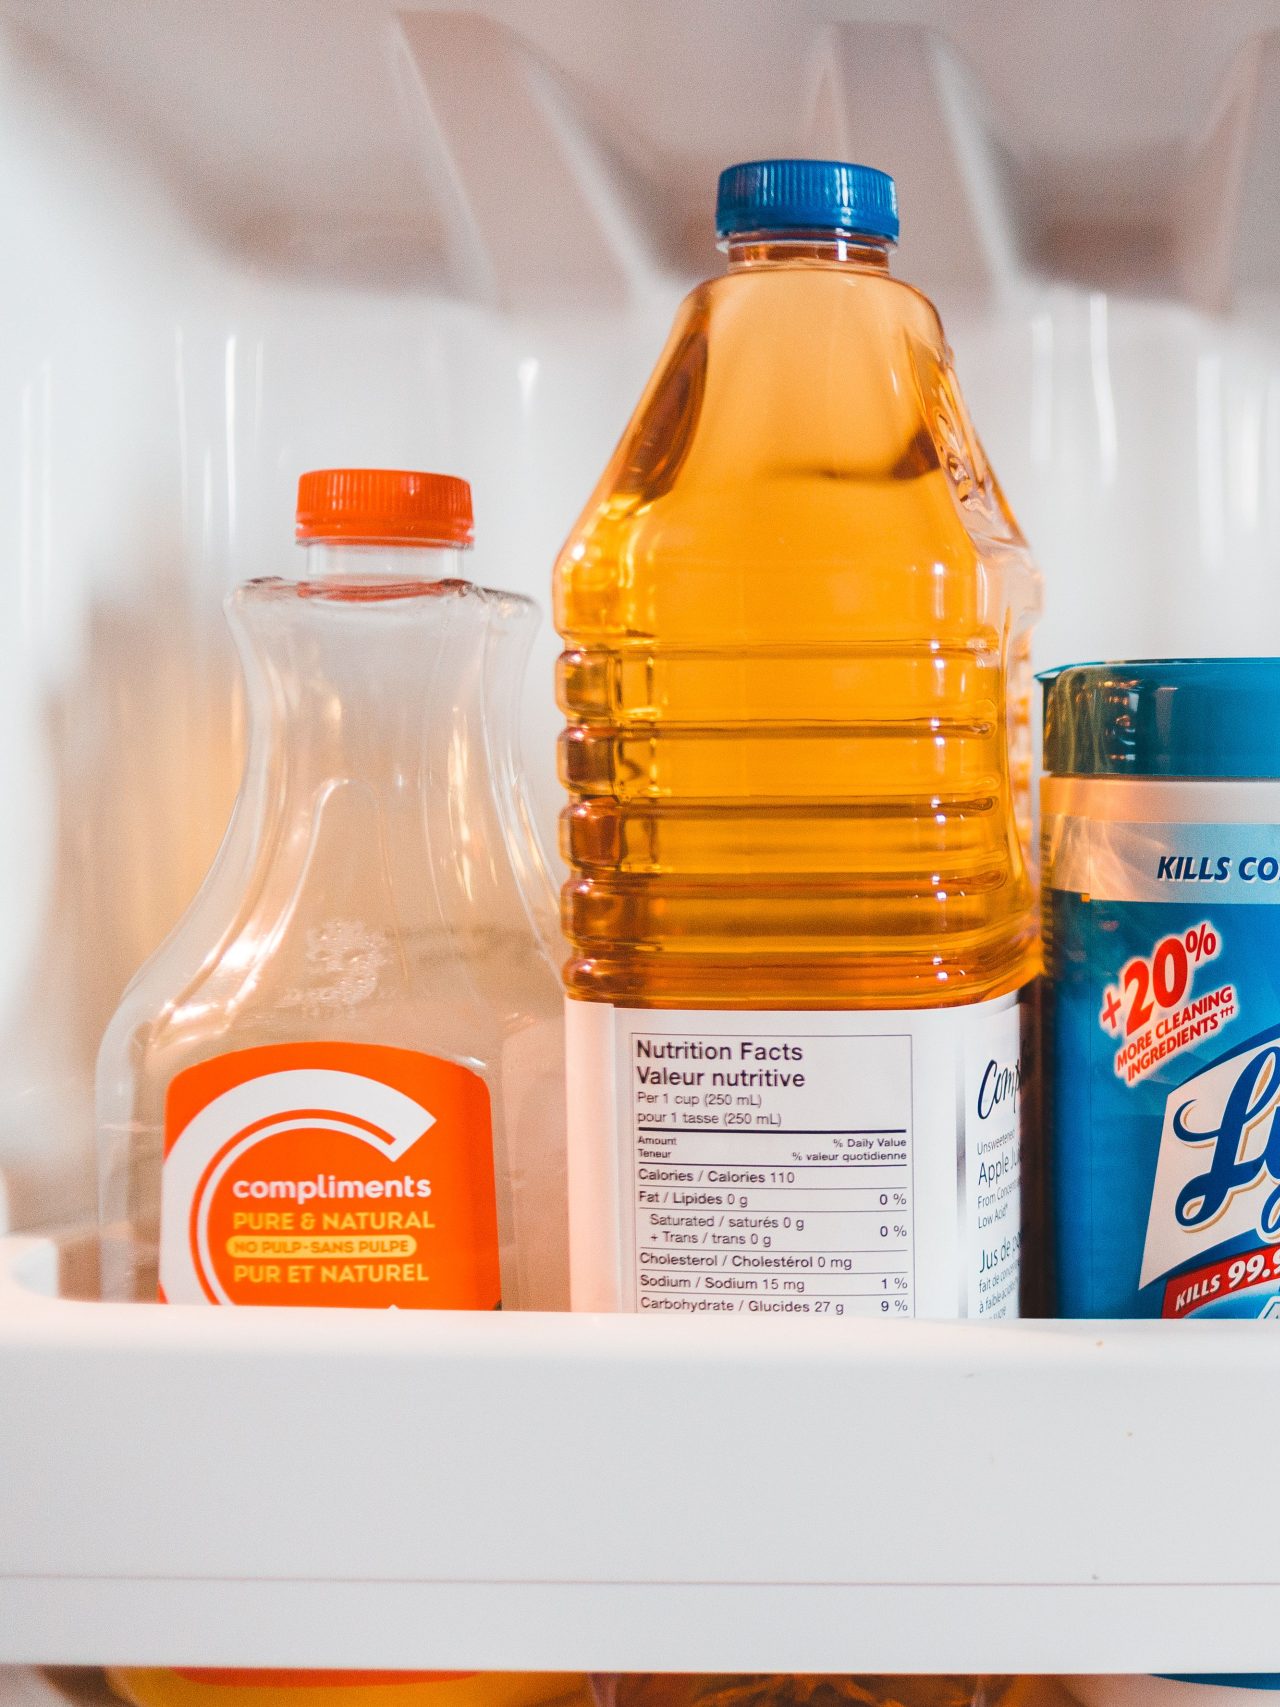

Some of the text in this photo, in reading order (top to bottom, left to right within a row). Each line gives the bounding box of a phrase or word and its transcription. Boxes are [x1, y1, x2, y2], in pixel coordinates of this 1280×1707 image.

[1157, 855, 1232, 882] KILLS
[1102, 923, 1217, 1036] +20%
[1117, 986, 1233, 1072] MORE CLEANING
[637, 1040, 803, 1061] Nutrition Facts
[637, 1066, 805, 1087] Valeur nutritive
[637, 1092, 762, 1108] Per 1 cup (250 mL)
[637, 1112, 782, 1127] pour 1 tasse (250 mL)
[638, 1136, 907, 1150] Amount % Daily Value
[638, 1149, 907, 1163] Teneur % valeur quotidienne
[638, 1169, 795, 1184] Calories Calories 110
[232, 1174, 431, 1205] compliments
[639, 1191, 907, 1208] Fat Lipides 0 g 0 %
[233, 1210, 435, 1231] PURE & NATURAL
[650, 1213, 805, 1231] Saturated saturés 0 g
[663, 1231, 771, 1248] Trans trans 0 g
[879, 1225, 907, 1238] 0 %
[233, 1240, 259, 1254] NO
[358, 1239, 409, 1253] PULPE
[639, 1252, 852, 1271] Cholesterol Cholestérol 0 mg
[979, 1248, 998, 1273] Jus
[233, 1264, 430, 1283] PUR ET NATUREL
[640, 1274, 908, 1293] Sodium Sodium 15 mg 1 %
[1175, 1273, 1221, 1312] KILLS
[640, 1296, 908, 1315] Carbohydrate Glucides 27 g 9 %
